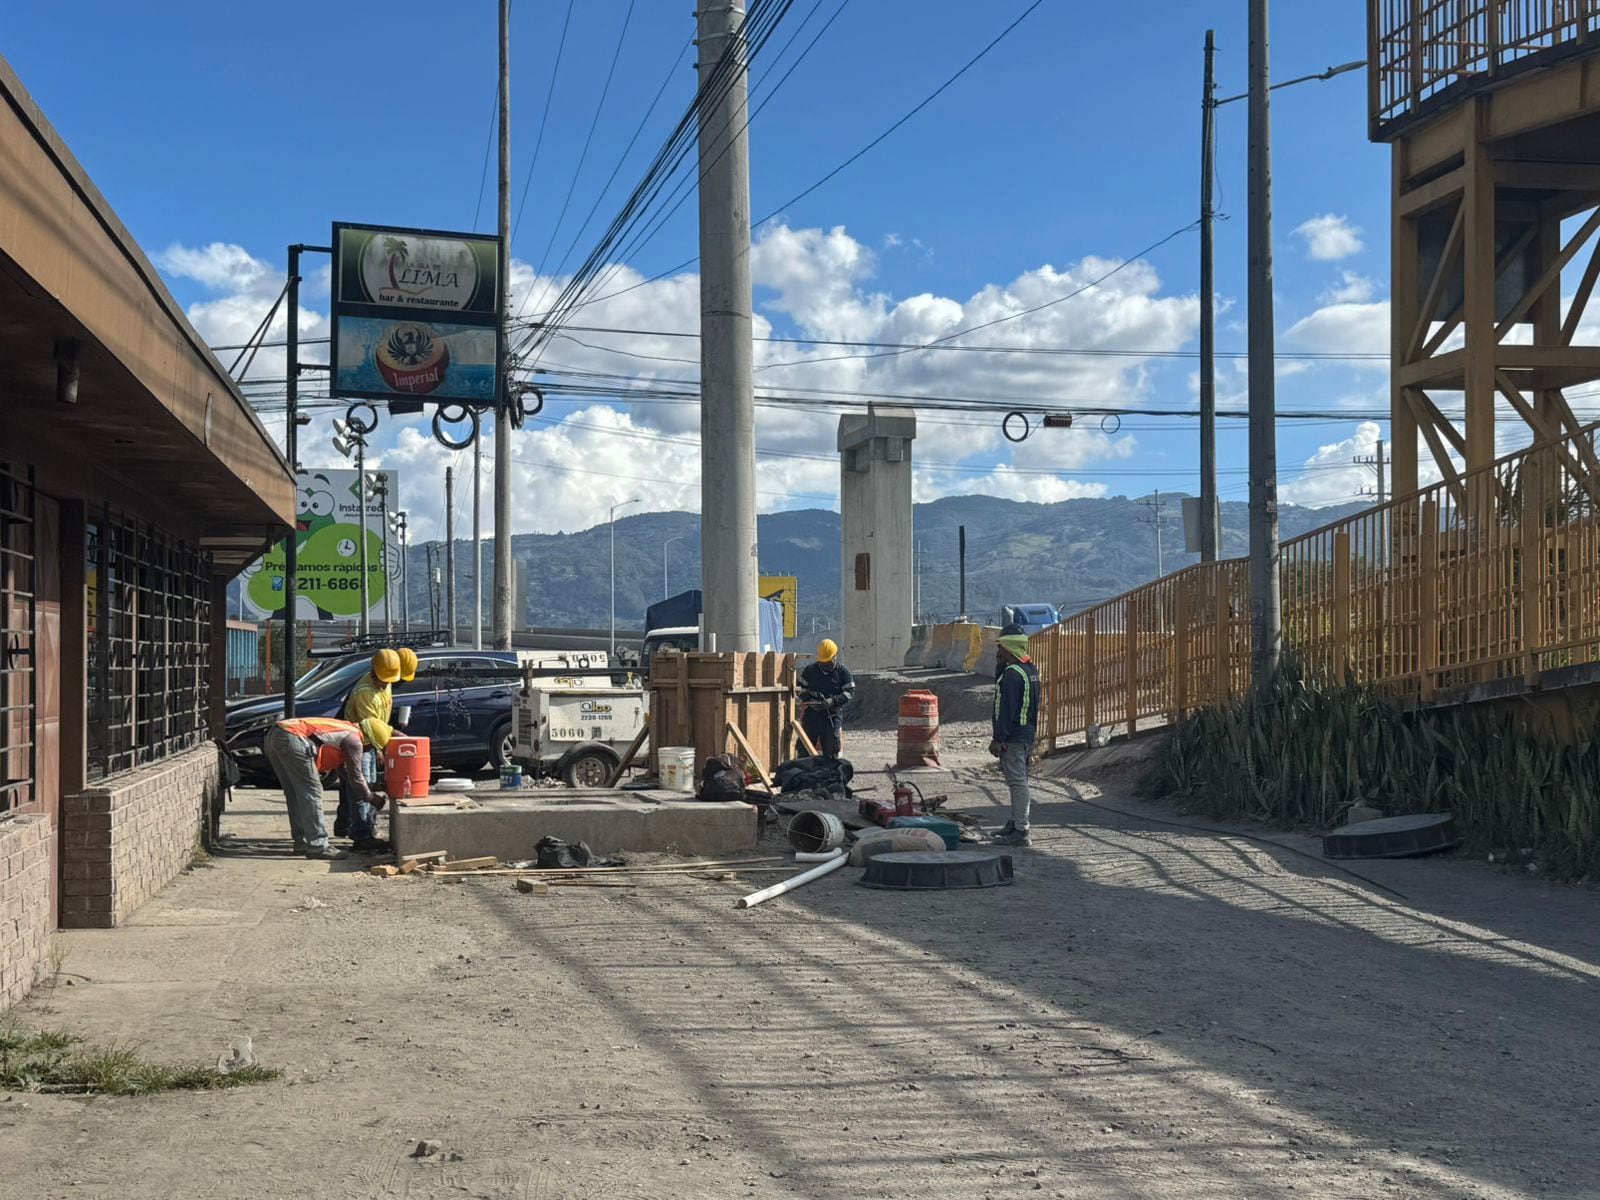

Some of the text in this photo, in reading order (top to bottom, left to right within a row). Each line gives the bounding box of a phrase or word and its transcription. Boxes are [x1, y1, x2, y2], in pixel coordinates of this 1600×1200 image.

[399, 269, 460, 288] LIMA
[379, 293, 395, 303] bar
[406, 296, 459, 307] restaurante
[392, 366, 439, 391] Imperial
[339, 503, 389, 512] Instared
[265, 562, 330, 572] Préamos
[580, 701, 612, 713] alco
[551, 728, 585, 737] 5060
